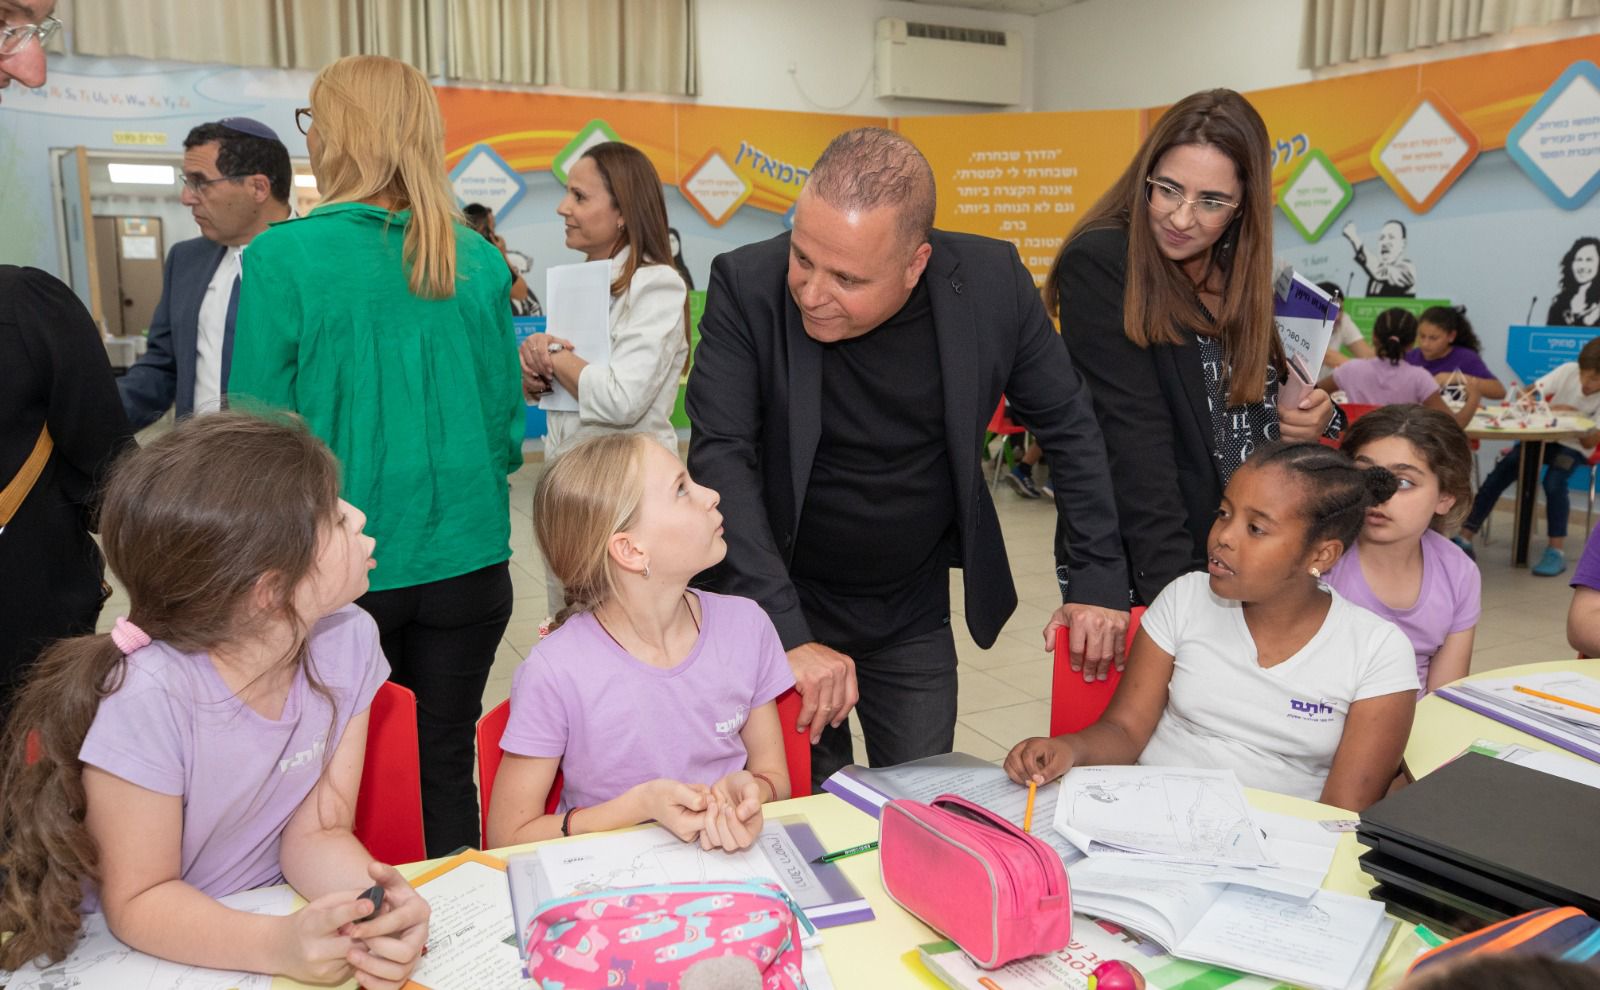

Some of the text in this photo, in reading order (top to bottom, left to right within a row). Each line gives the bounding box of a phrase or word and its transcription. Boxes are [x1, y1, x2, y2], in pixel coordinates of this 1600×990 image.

[65, 88, 77, 101] Ss
[163, 96, 175, 109] Yy
[734, 139, 811, 186] המאזין
[969, 149, 1061, 163] "הדרך שבחרתי,
[953, 166, 1077, 180] ושבחרתי לי למטרתי,
[957, 185, 1071, 198] איננה הקצרה ביותר
[954, 201, 1074, 214] וגם לא הנוחה ביותר,
[1000, 221, 1026, 231] ברם,
[1029, 257, 1055, 266] שום
[1286, 329, 1300, 342] ספר
